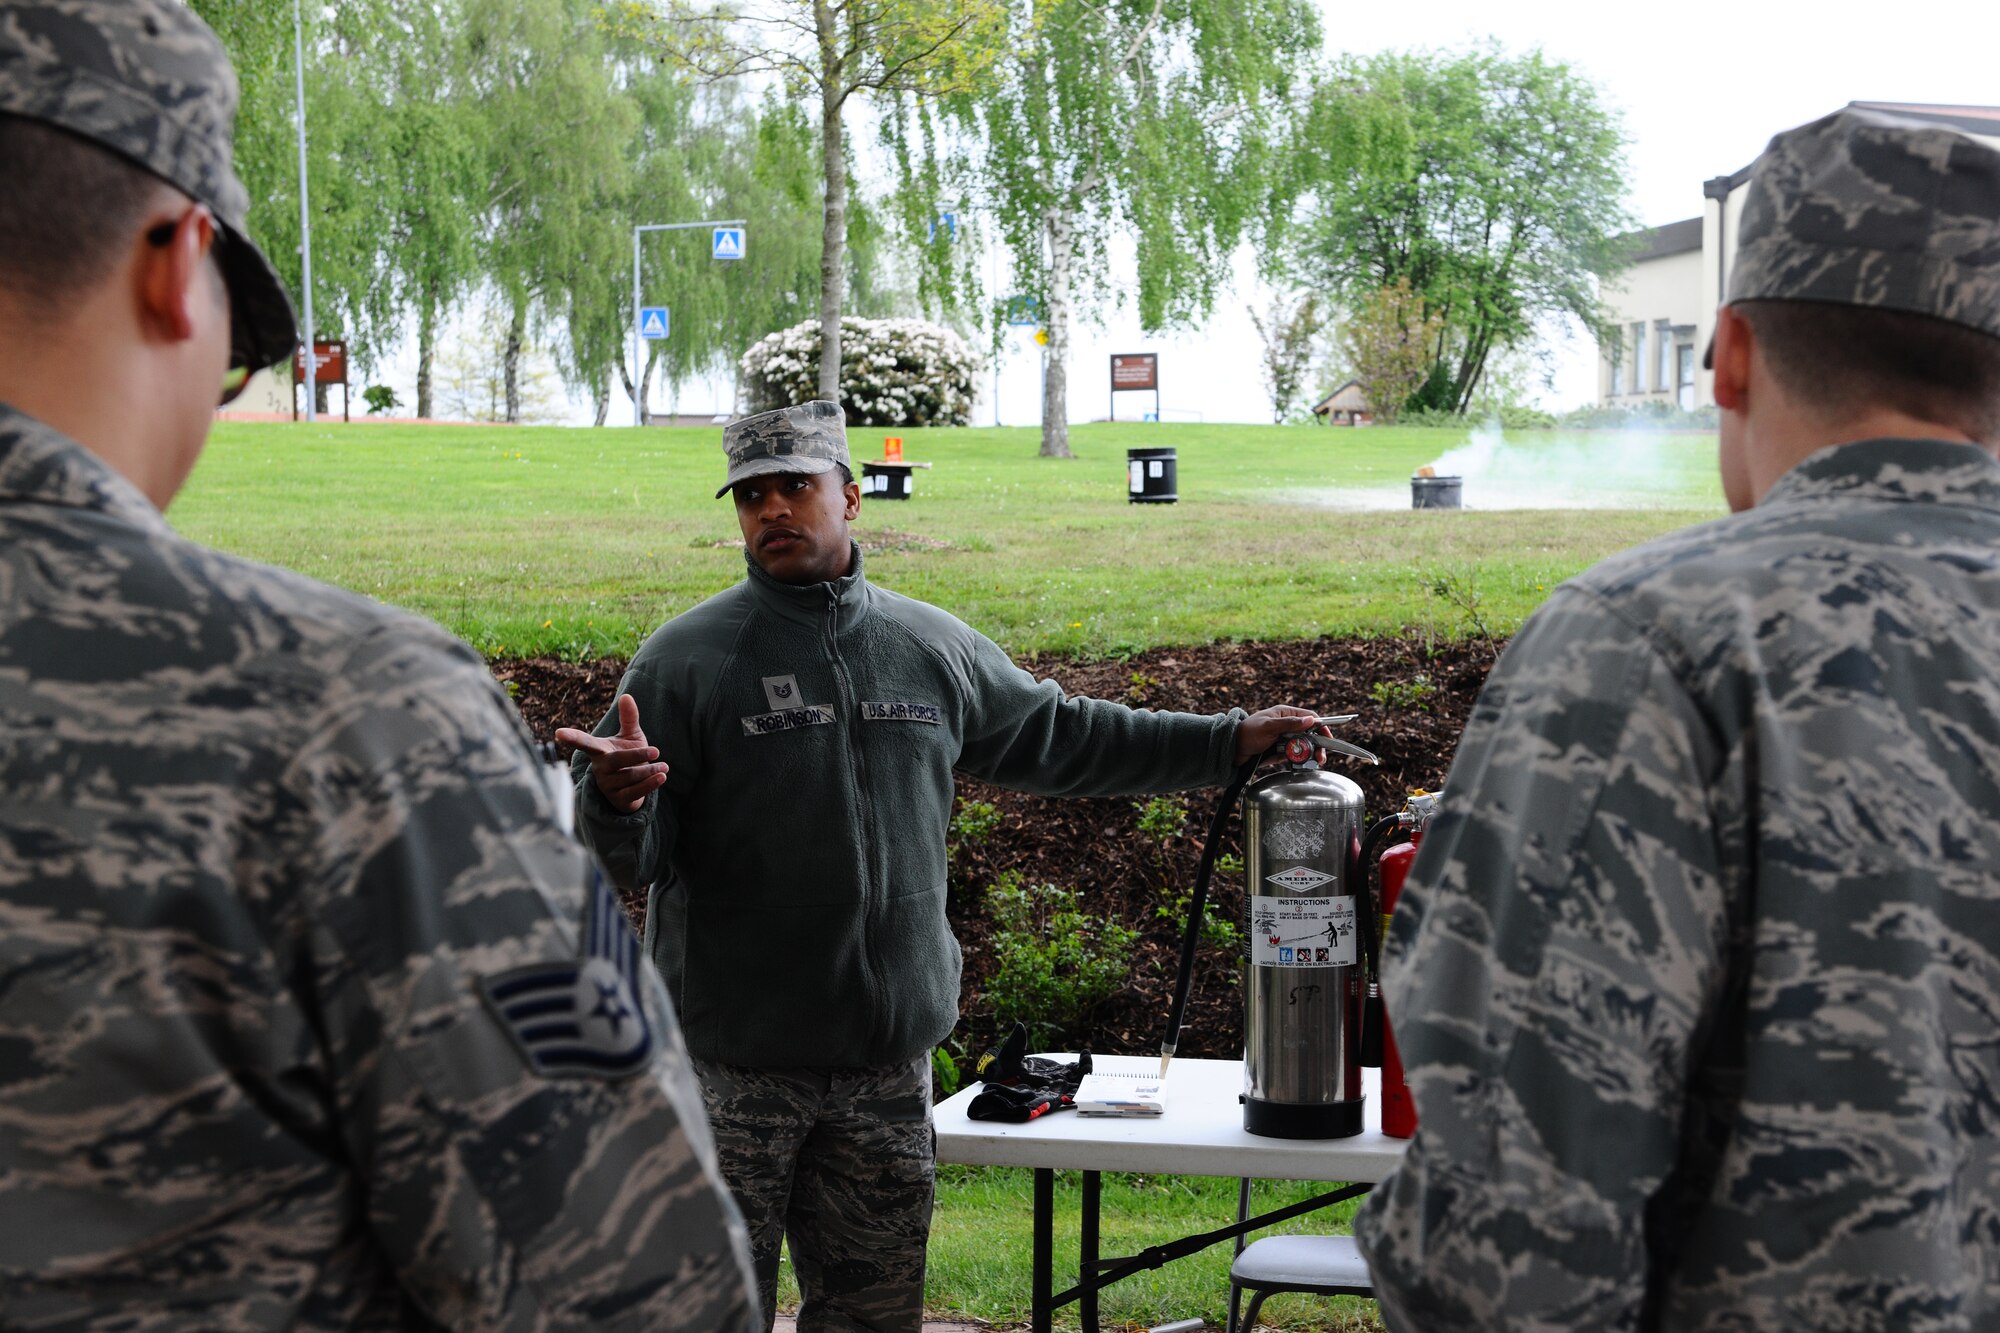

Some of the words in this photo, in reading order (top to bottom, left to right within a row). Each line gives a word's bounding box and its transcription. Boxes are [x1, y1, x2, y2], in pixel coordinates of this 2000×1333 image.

[756, 708, 822, 732] ROBINSON
[869, 704, 889, 718] U.S.
[890, 705, 907, 719] AIR
[908, 706, 938, 721] FORCE
